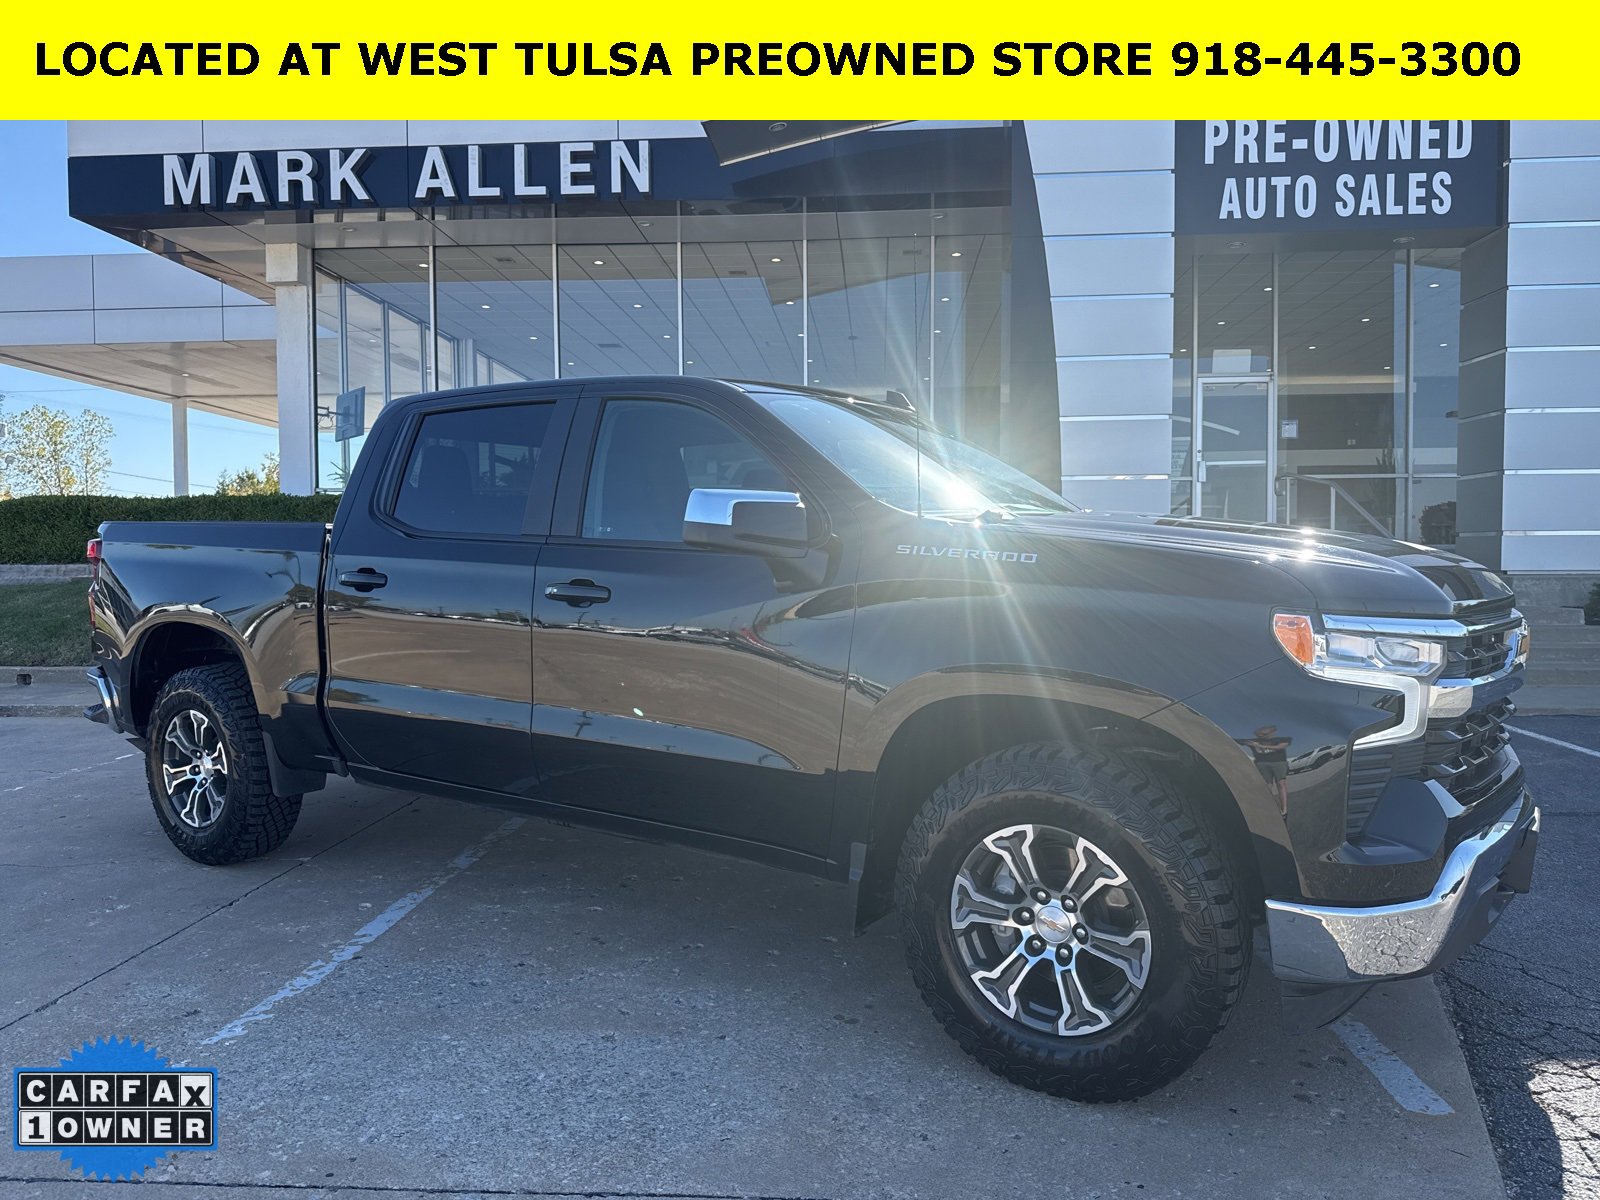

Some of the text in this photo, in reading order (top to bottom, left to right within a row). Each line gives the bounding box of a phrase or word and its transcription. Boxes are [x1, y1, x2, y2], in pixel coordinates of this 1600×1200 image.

[1204, 120, 1473, 164] PRE-OWNED
[163, 140, 651, 206] MARK ALLEN
[1219, 171, 1452, 219] AUTO SALES
[895, 544, 1038, 564] SILVERADO
